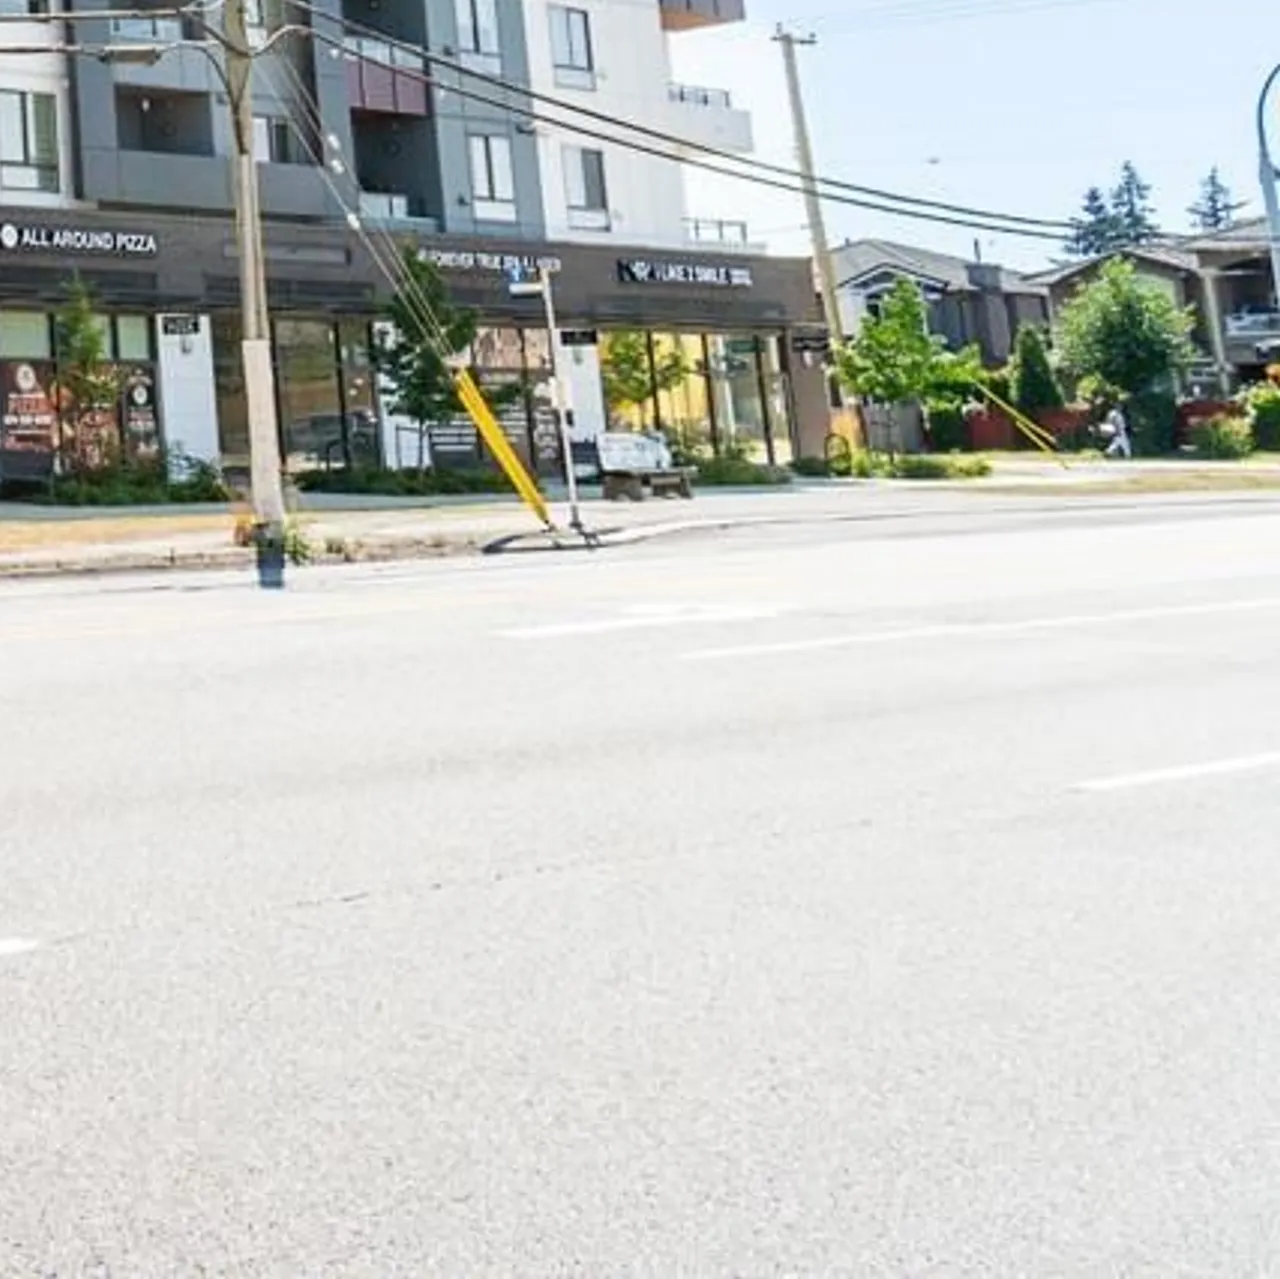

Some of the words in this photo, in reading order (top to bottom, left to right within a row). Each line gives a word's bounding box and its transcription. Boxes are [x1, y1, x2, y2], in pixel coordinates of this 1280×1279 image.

[22, 228, 48, 246] ALL
[52, 229, 114, 250] AROUND
[116, 232, 157, 253] PIZZA
